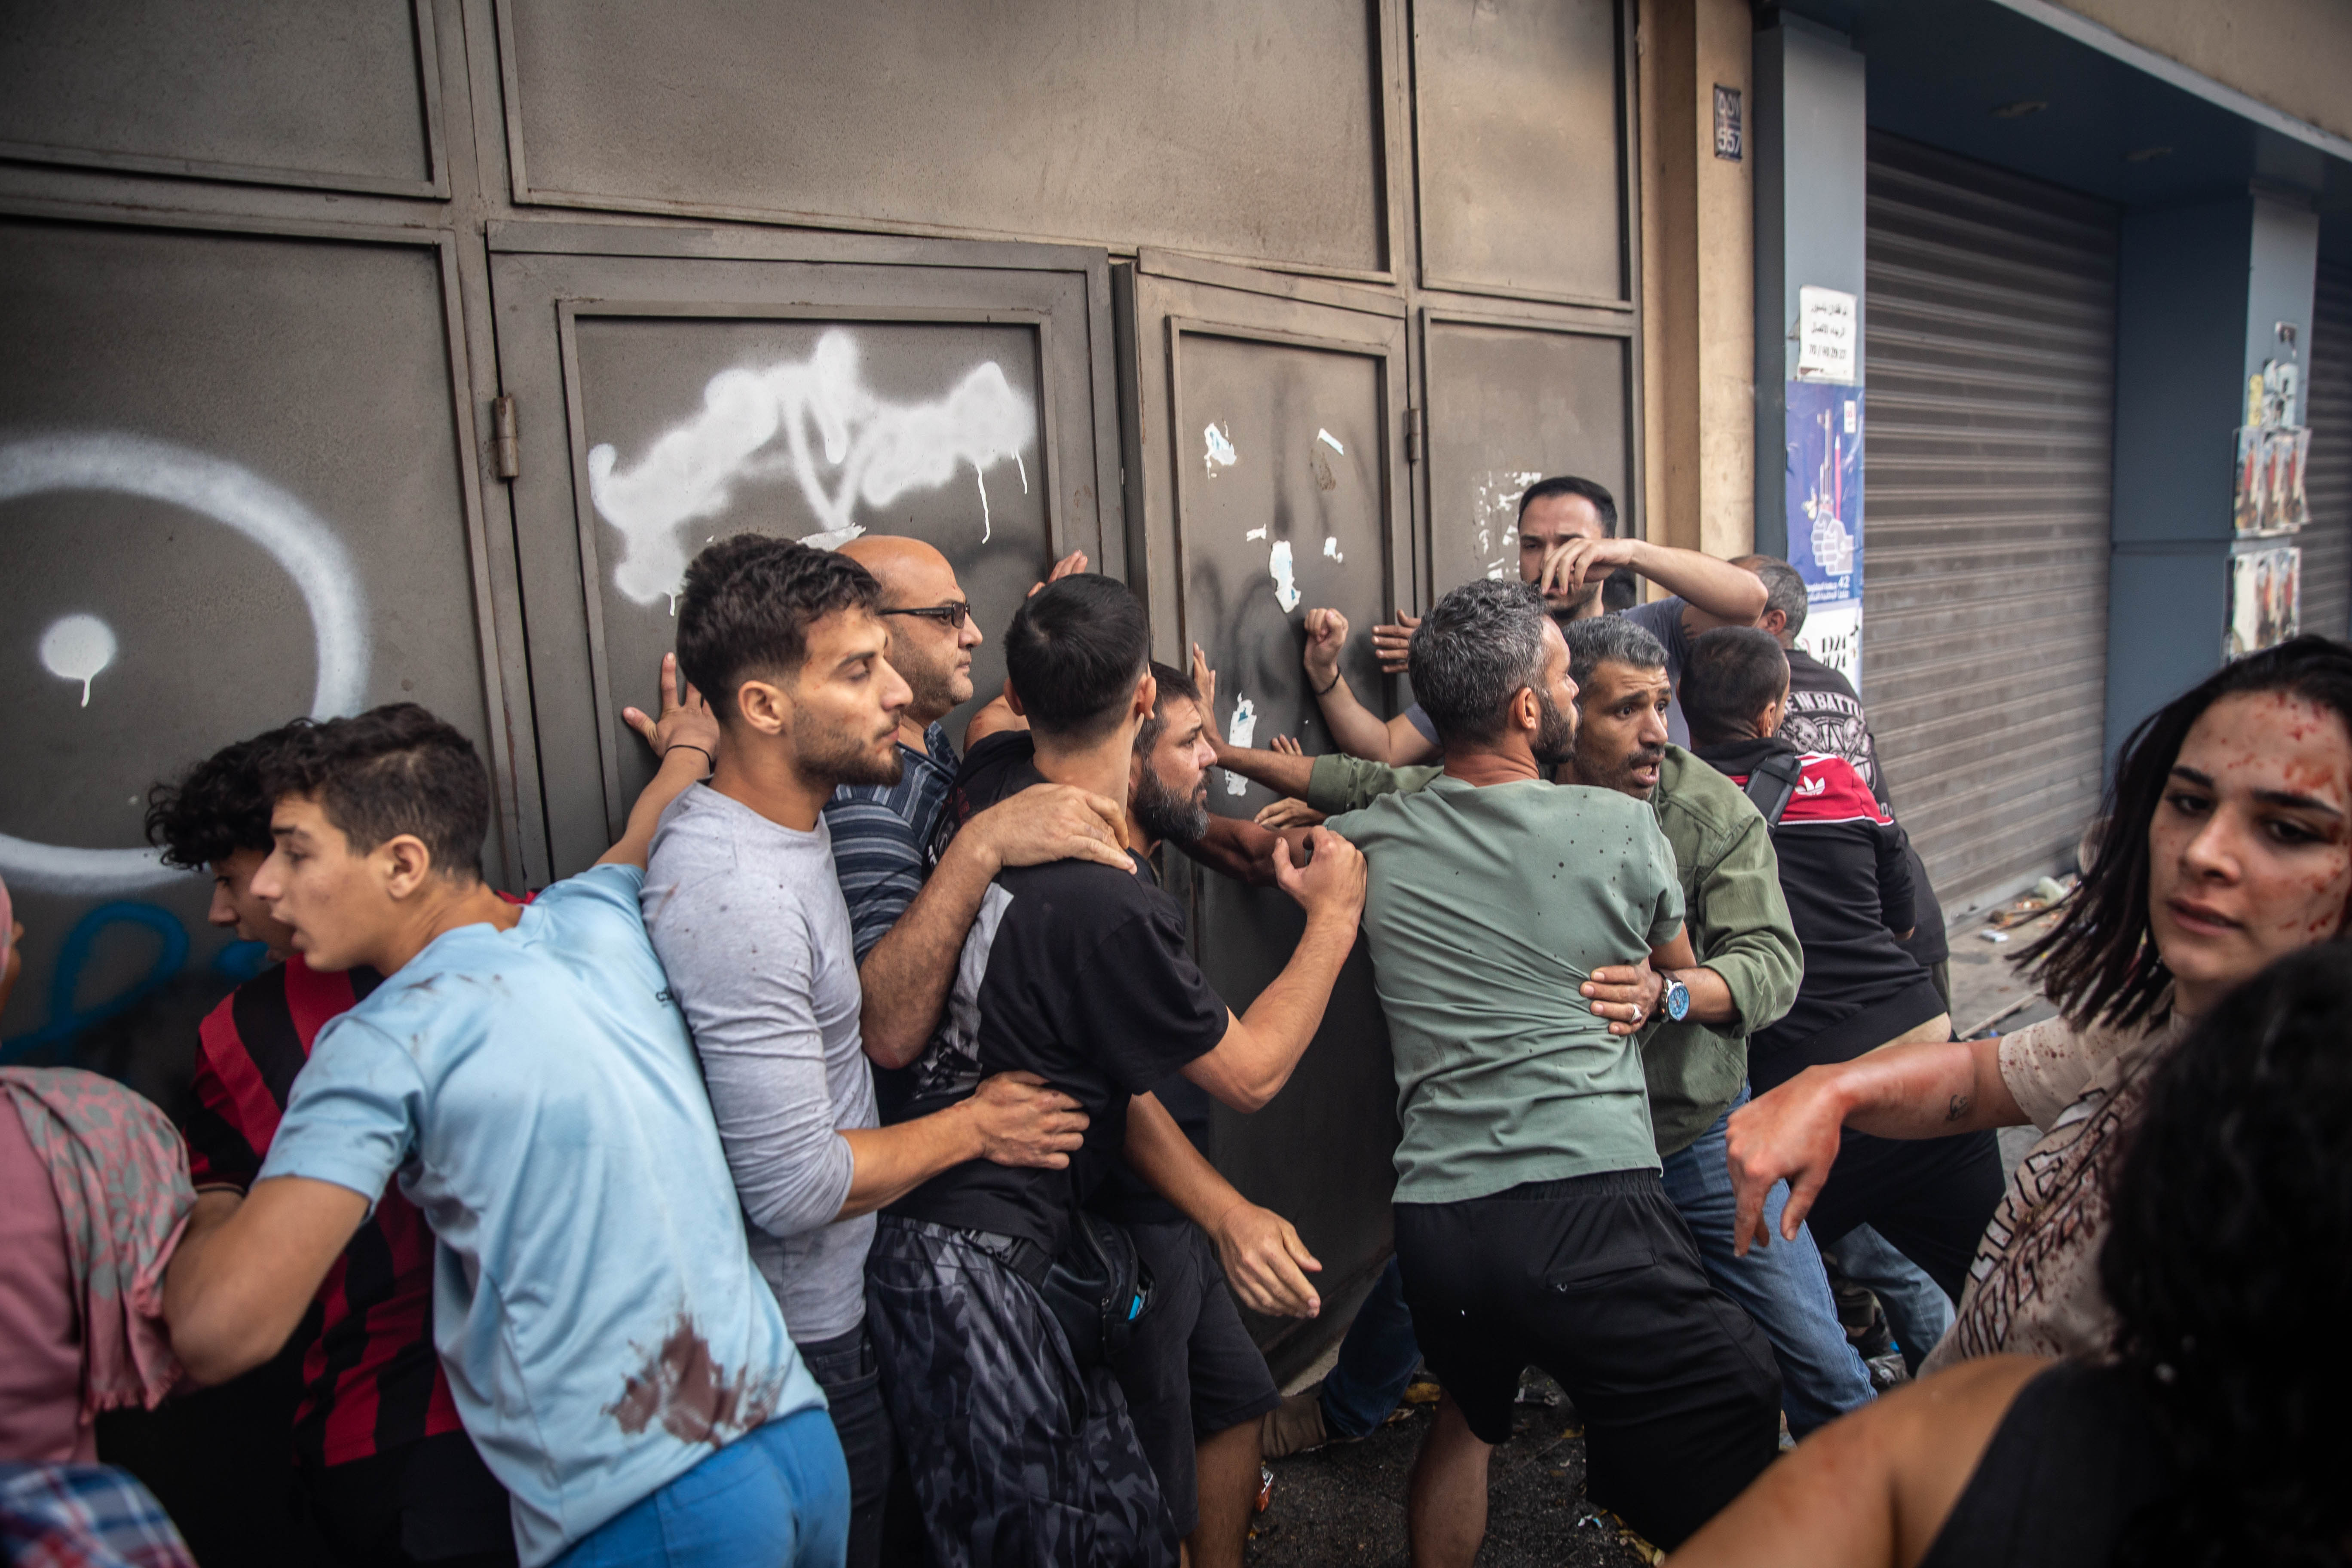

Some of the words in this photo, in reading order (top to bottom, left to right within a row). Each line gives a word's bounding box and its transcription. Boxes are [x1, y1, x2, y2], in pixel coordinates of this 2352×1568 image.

[1718, 126, 1740, 155] 557
[1838, 575, 1850, 588] 42
[1794, 693, 1816, 711] IN
